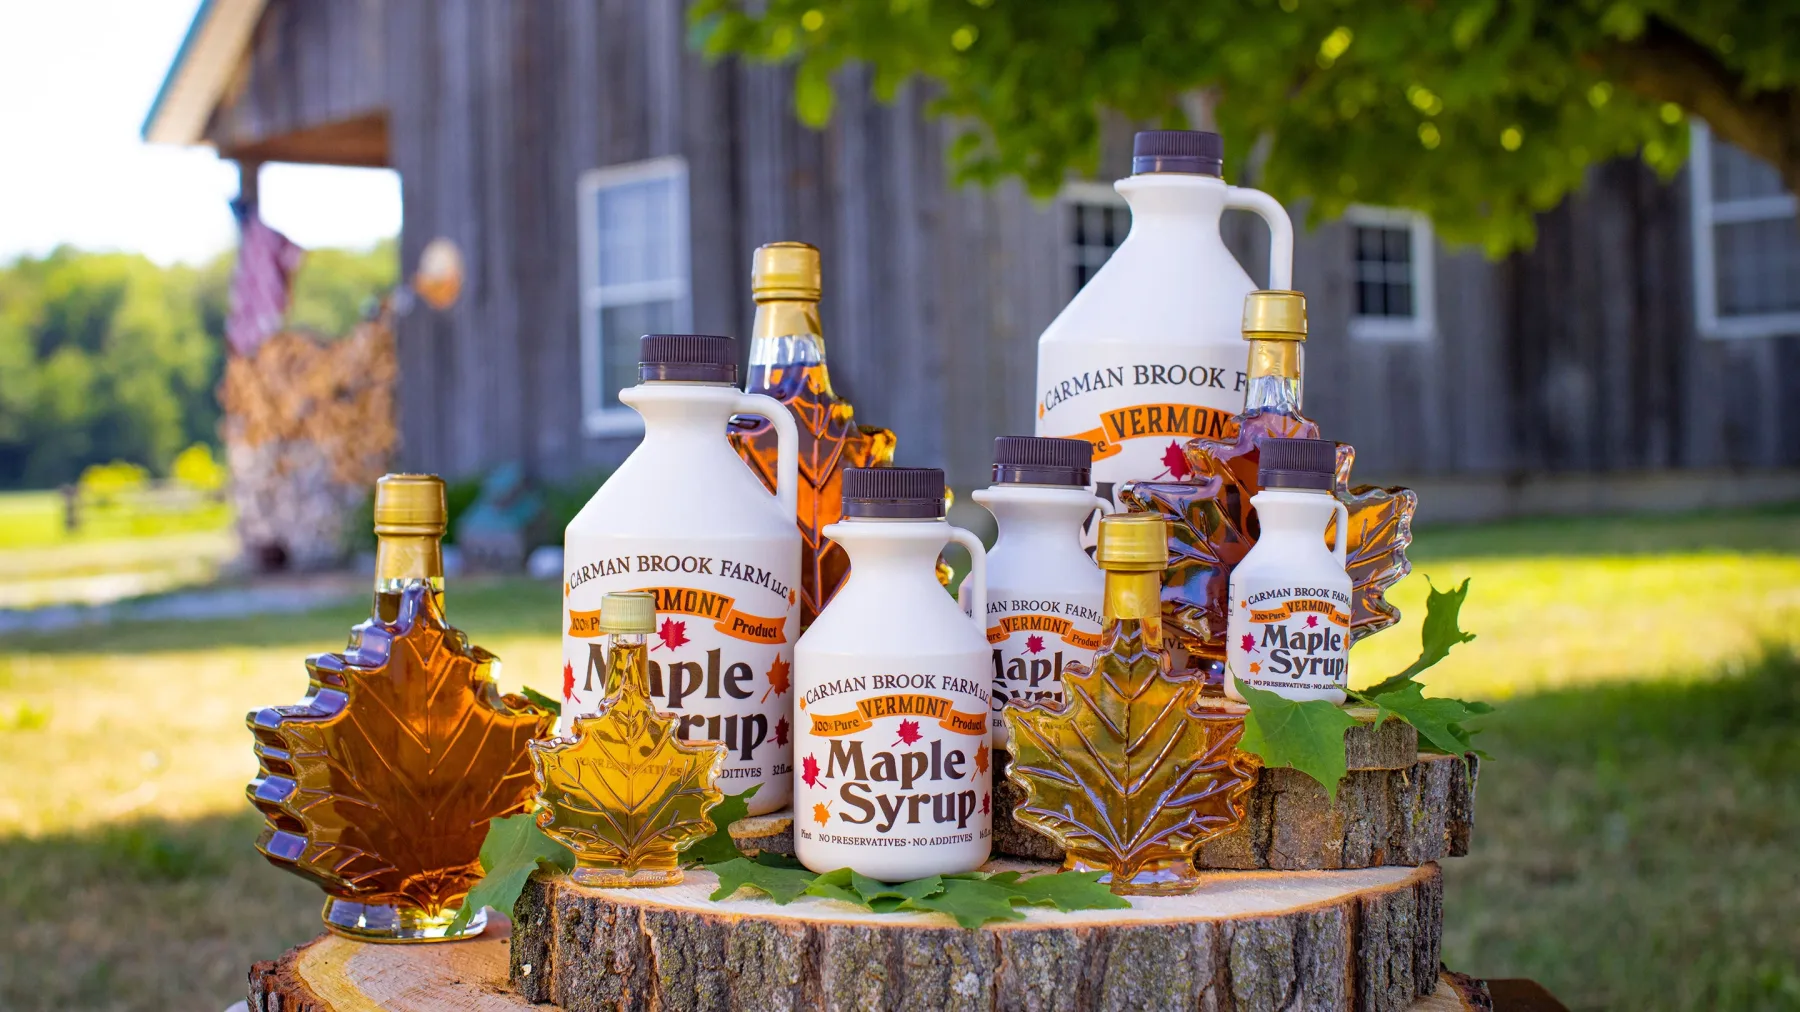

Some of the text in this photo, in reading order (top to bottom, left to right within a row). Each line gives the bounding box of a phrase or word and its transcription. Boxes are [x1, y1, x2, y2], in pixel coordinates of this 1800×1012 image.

[1045, 366, 1123, 411] CARMAN
[1133, 364, 1225, 389] BROOK
[1110, 405, 1229, 438] VERMON
[570, 555, 788, 599] CARMAN BROOK FARM LLC
[643, 588, 729, 618] RMONT
[1248, 588, 1290, 605] CARMAN
[1294, 587, 1330, 598] BROOK
[1011, 600, 1060, 613] BROOK
[1065, 603, 1097, 622] FARM
[1286, 600, 1336, 615] VERMONT
[732, 617, 777, 638] Product
[1002, 616, 1070, 635] VERMONT
[986, 632, 1001, 641] ure
[1072, 633, 1099, 647] Product
[1260, 624, 1341, 655] Maple
[992, 649, 1081, 687] apl
[1268, 648, 1344, 680] Syrup
[806, 676, 866, 705] CARMAN
[872, 674, 936, 689] BROOK
[942, 676, 979, 697] FARM
[1263, 681, 1310, 690] PRESERVATIVES
[861, 694, 948, 718] VERMONT
[834, 719, 860, 731] Pure
[952, 716, 982, 730] Product
[679, 713, 768, 760] rup
[721, 767, 762, 779] DITIVES
[772, 764, 780, 776] 32
[825, 739, 966, 790] Maple
[839, 782, 977, 833] Syrup
[818, 833, 906, 847] NO PRESERVATIVES
[913, 837, 927, 846] NO
[929, 832, 973, 846] ADDITIVES
